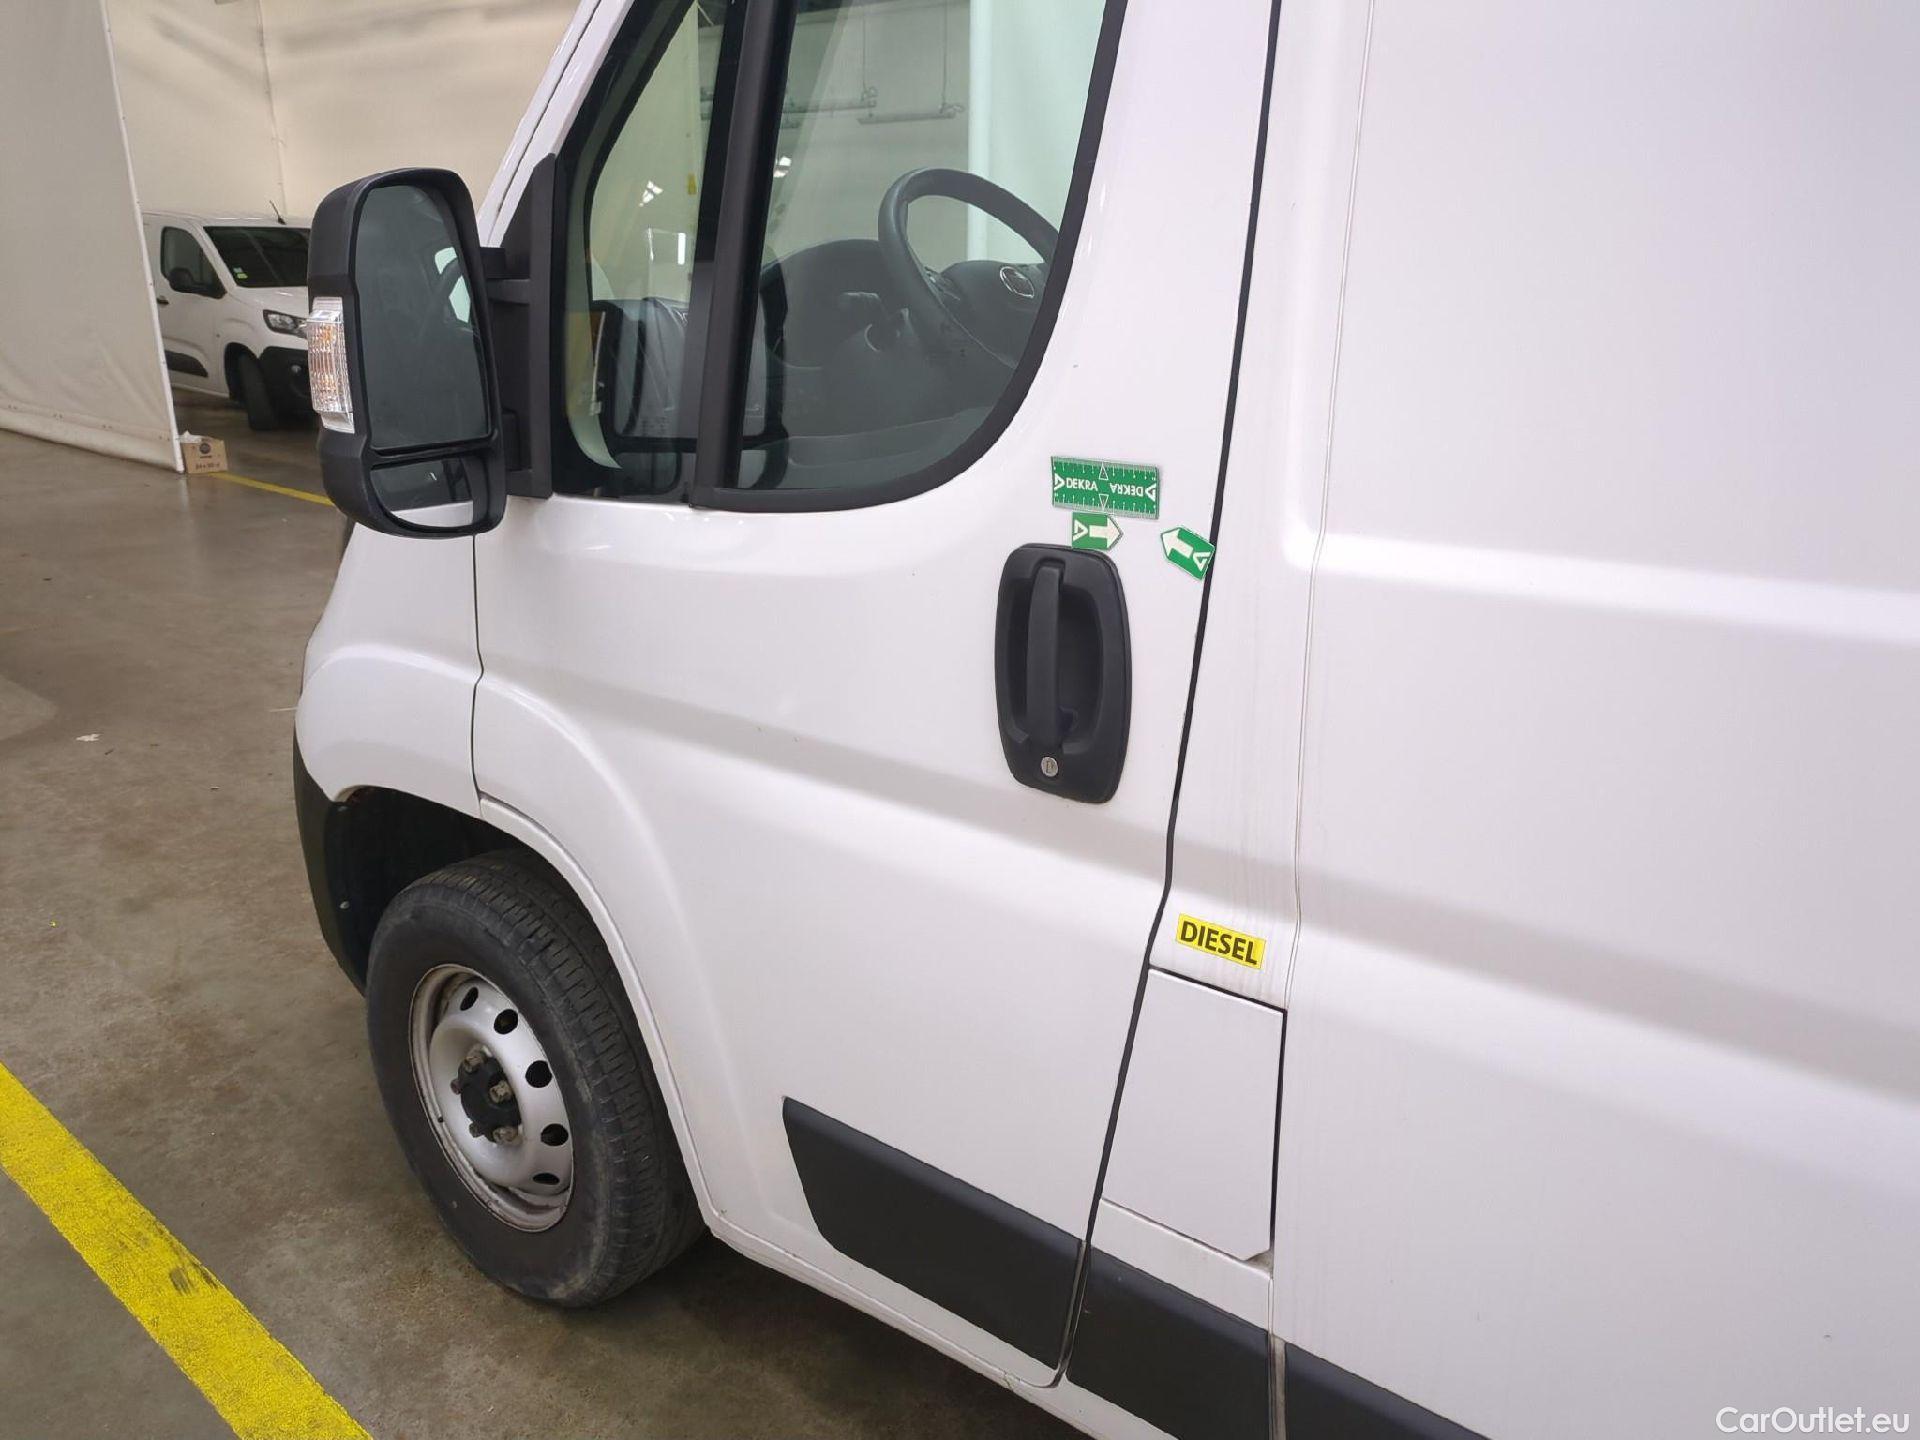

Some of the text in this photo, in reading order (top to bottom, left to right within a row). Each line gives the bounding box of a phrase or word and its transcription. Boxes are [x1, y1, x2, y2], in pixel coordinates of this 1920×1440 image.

[1066, 477, 1098, 492] DEKRA
[1109, 483, 1144, 497] DEKRA
[1180, 920, 1257, 966] DIESEL
